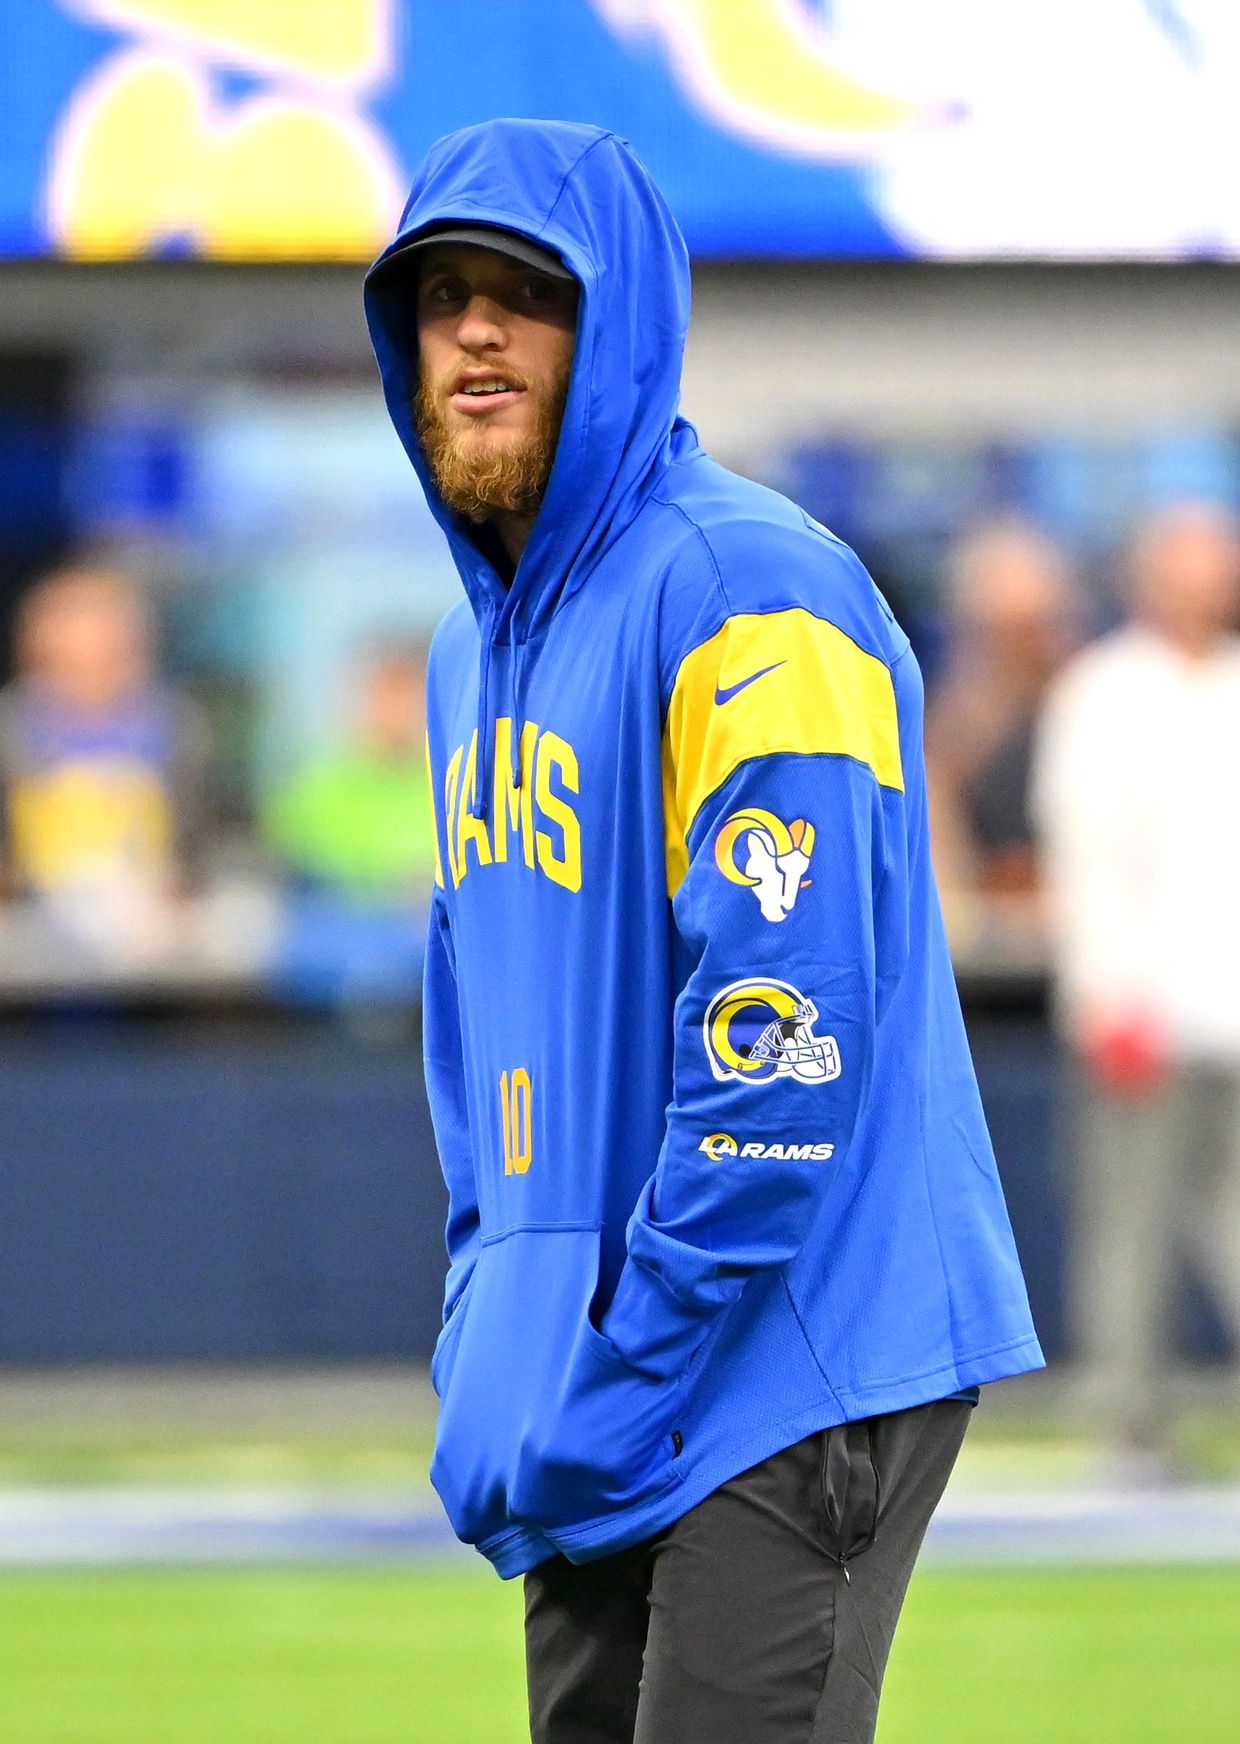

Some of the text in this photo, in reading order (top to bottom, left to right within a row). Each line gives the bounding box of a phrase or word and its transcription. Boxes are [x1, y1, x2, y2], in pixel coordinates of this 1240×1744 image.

[499, 1067, 532, 1176] 10
[698, 1133, 835, 1161] LA RAMS
